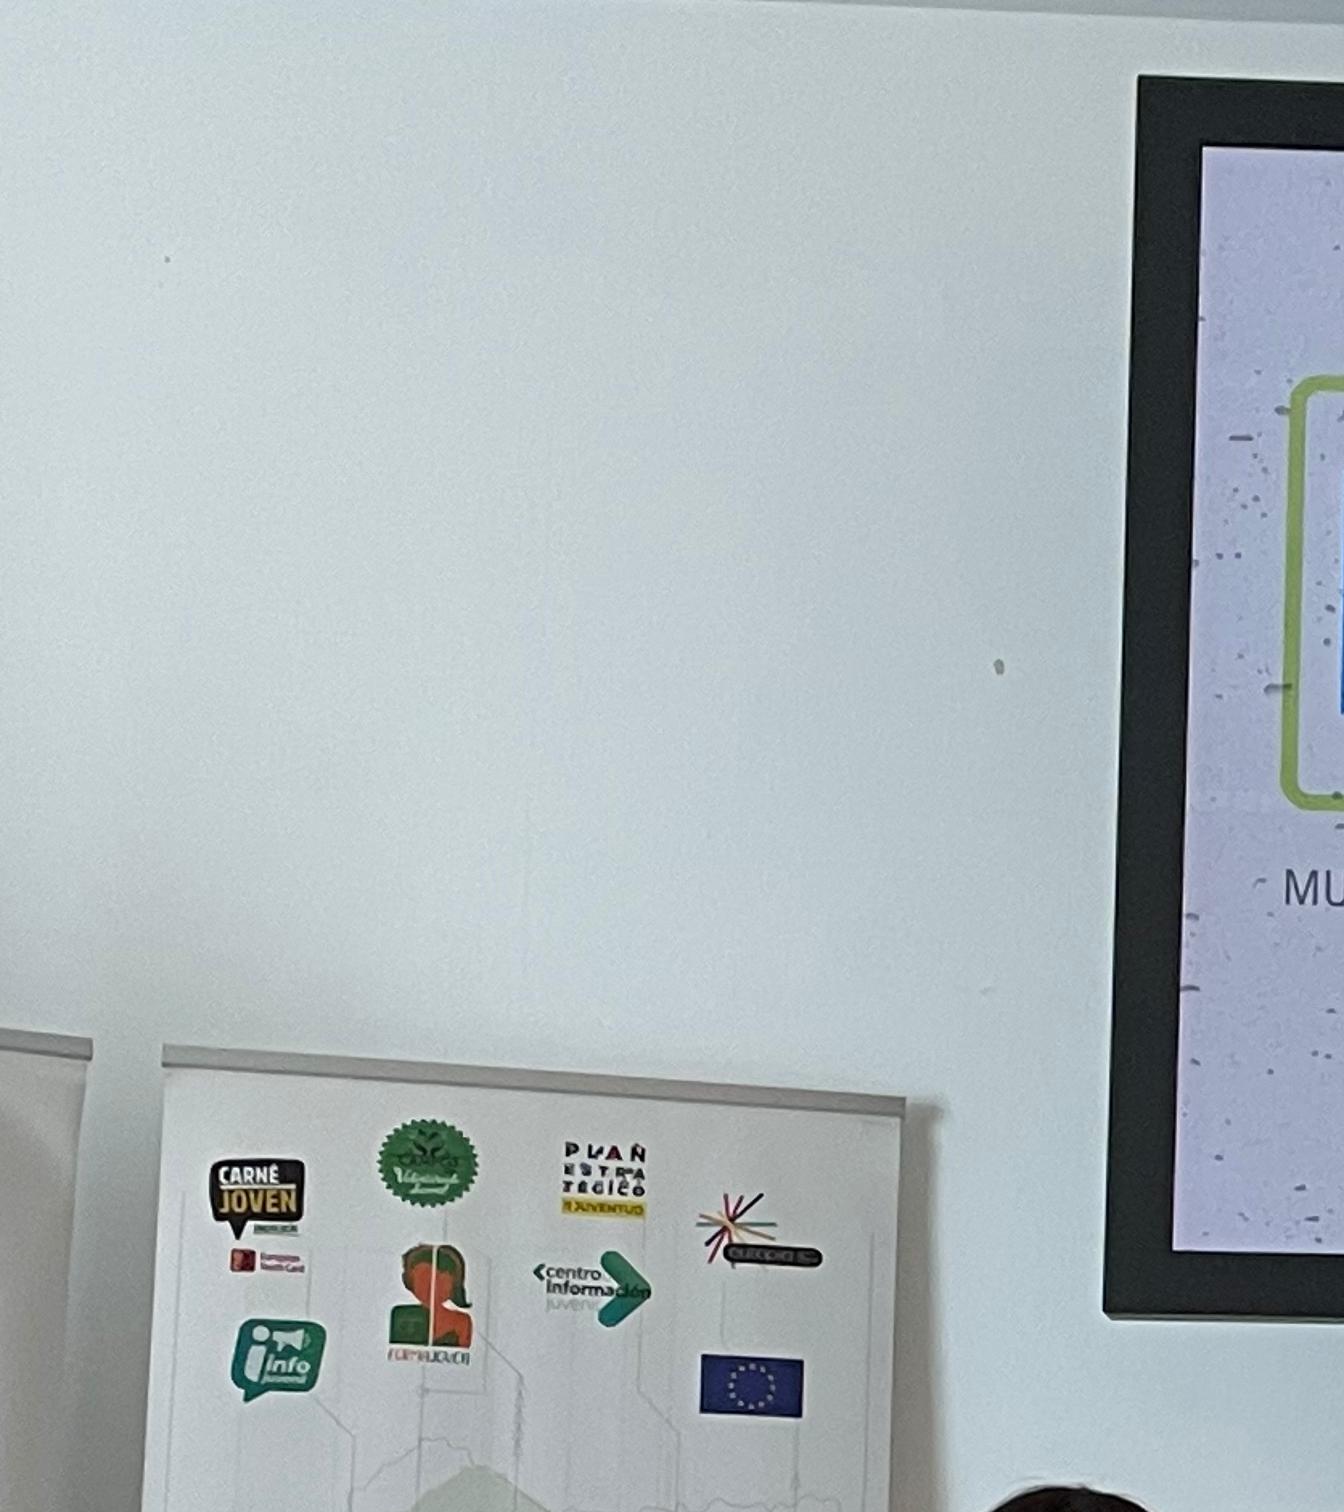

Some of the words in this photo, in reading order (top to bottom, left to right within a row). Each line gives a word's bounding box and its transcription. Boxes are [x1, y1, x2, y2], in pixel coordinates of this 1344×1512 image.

[218, 1163, 280, 1185] CARNÉ
[219, 1189, 297, 1214] JOVEN
[546, 1266, 602, 1281] centro
[267, 1354, 311, 1374] info
